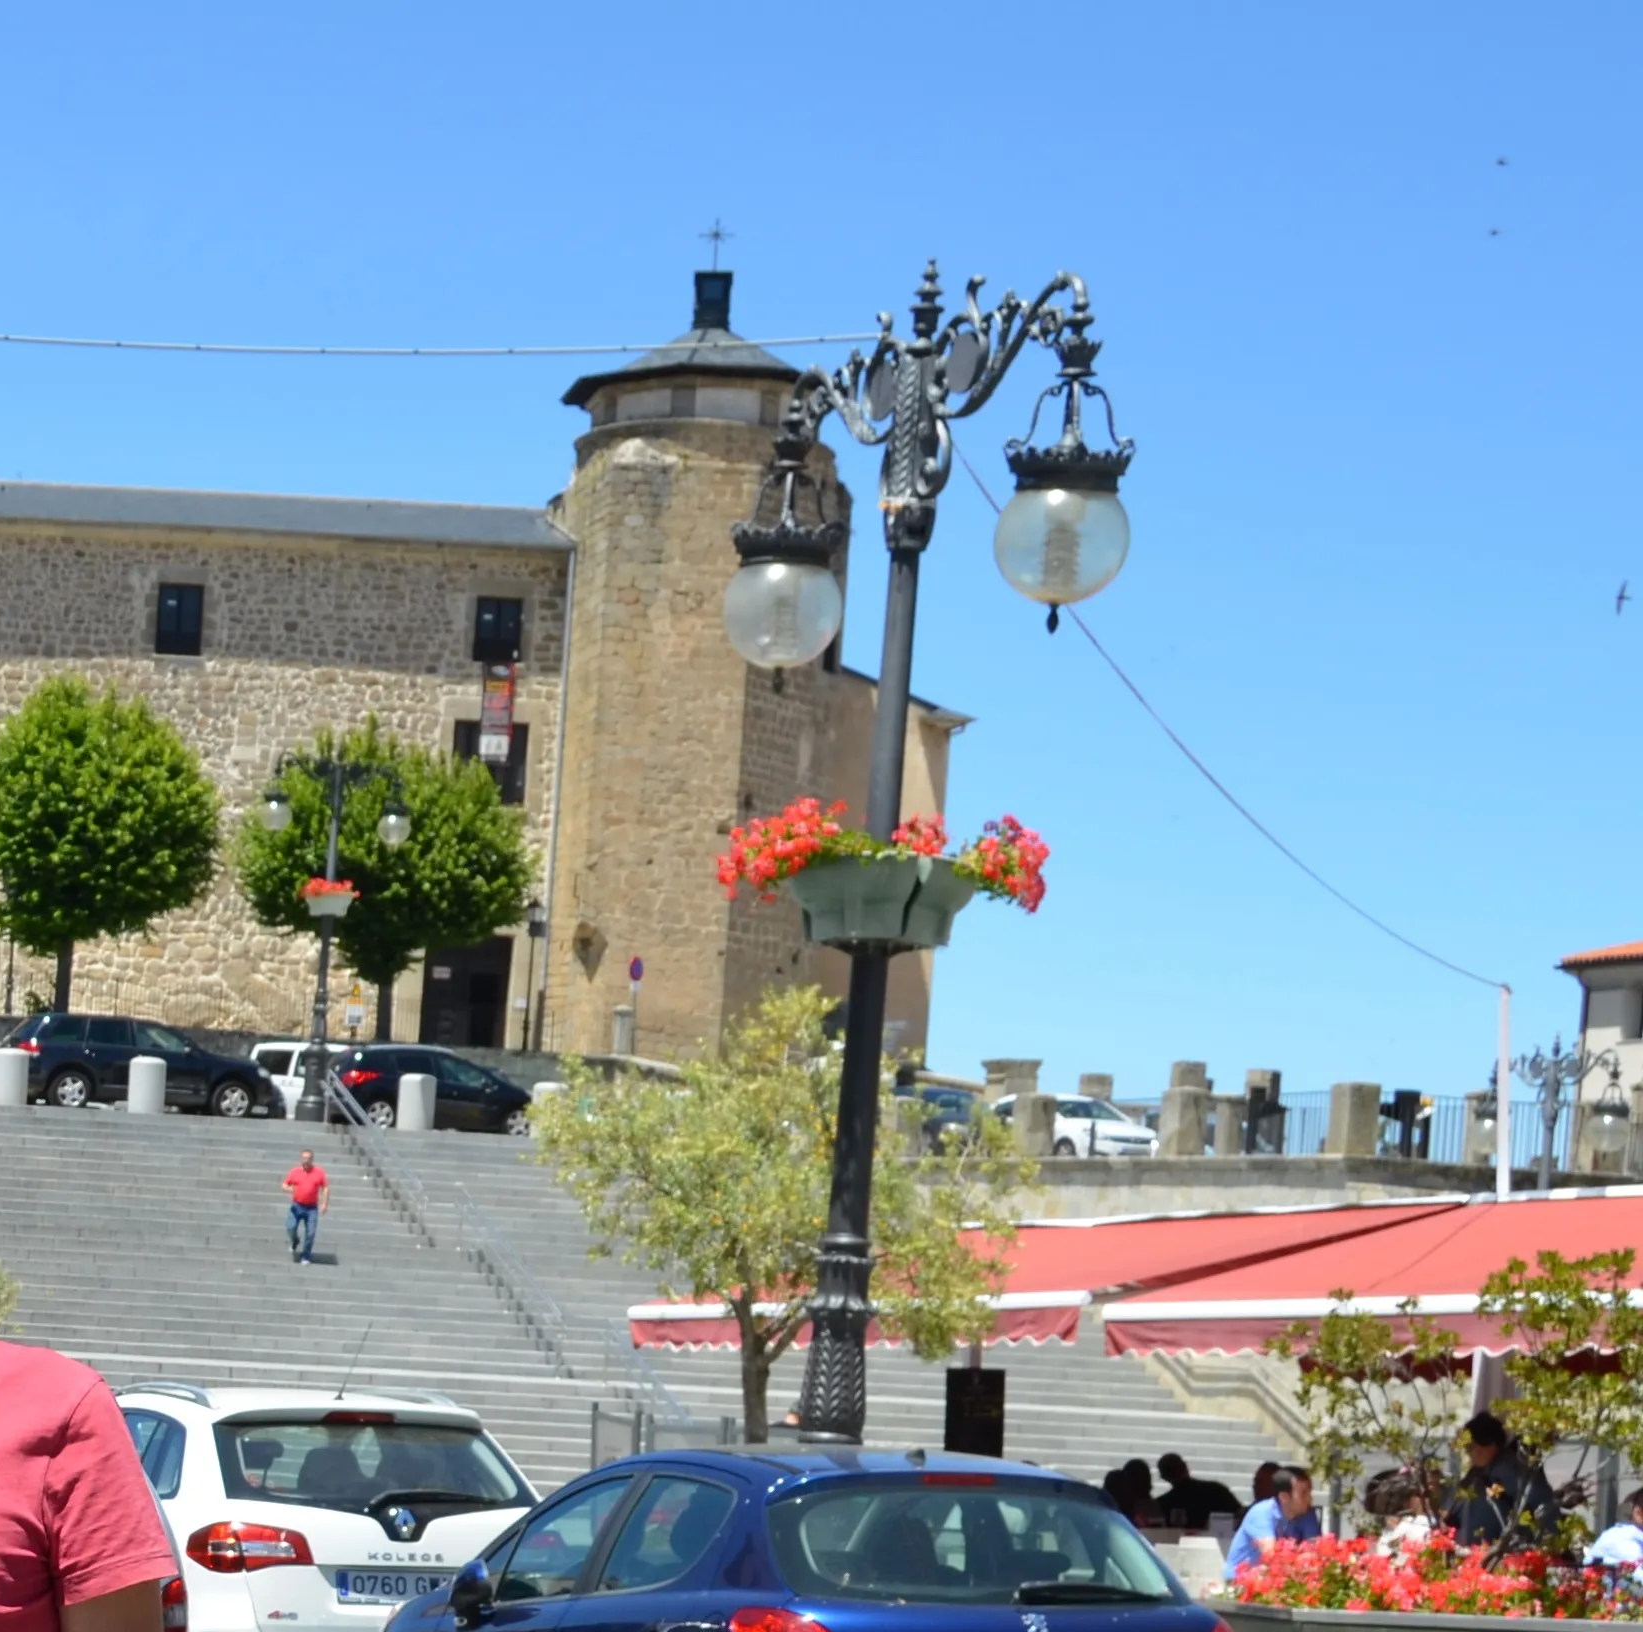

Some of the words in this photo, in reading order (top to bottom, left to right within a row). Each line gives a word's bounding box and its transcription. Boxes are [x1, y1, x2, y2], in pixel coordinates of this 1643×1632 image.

[367, 1551, 445, 1563] KOLEOS
[352, 1574, 408, 1596] 0760
[415, 1576, 448, 1596] GW
